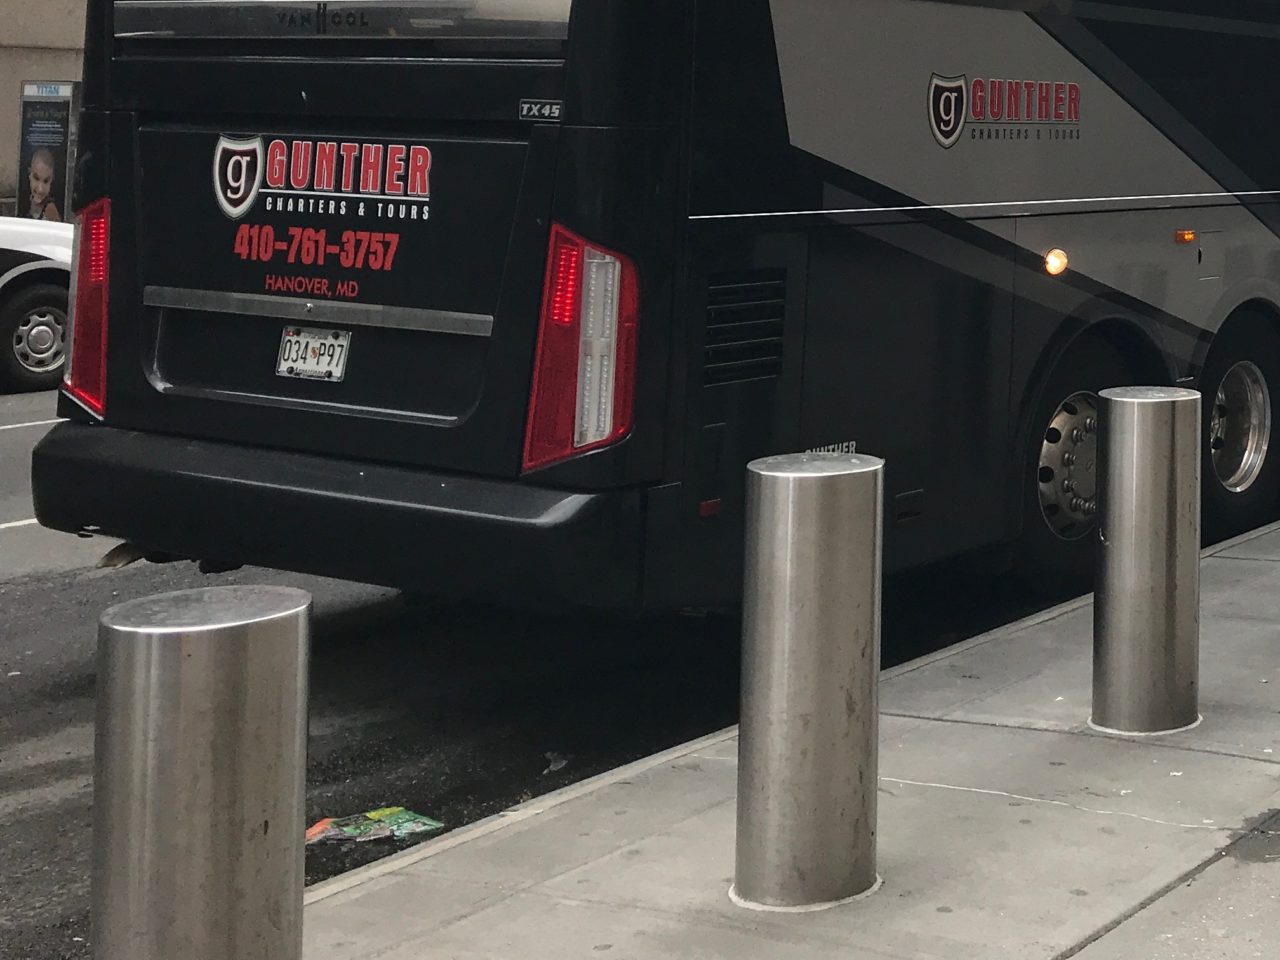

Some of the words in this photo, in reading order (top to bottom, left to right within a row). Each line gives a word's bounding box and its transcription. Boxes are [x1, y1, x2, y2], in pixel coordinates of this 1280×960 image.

[970, 78, 1081, 121] GUNTHER
[971, 128, 1029, 140] CHARTERS
[1049, 128, 1080, 140] TOURS
[266, 139, 431, 195] GUNTHER
[266, 196, 347, 215] CHARTERS
[358, 202, 365, 216] &
[377, 203, 429, 220] TOURS
[234, 223, 400, 271] 410-761-3757
[265, 275, 333, 297] HANOVER,
[336, 280, 359, 297] MD
